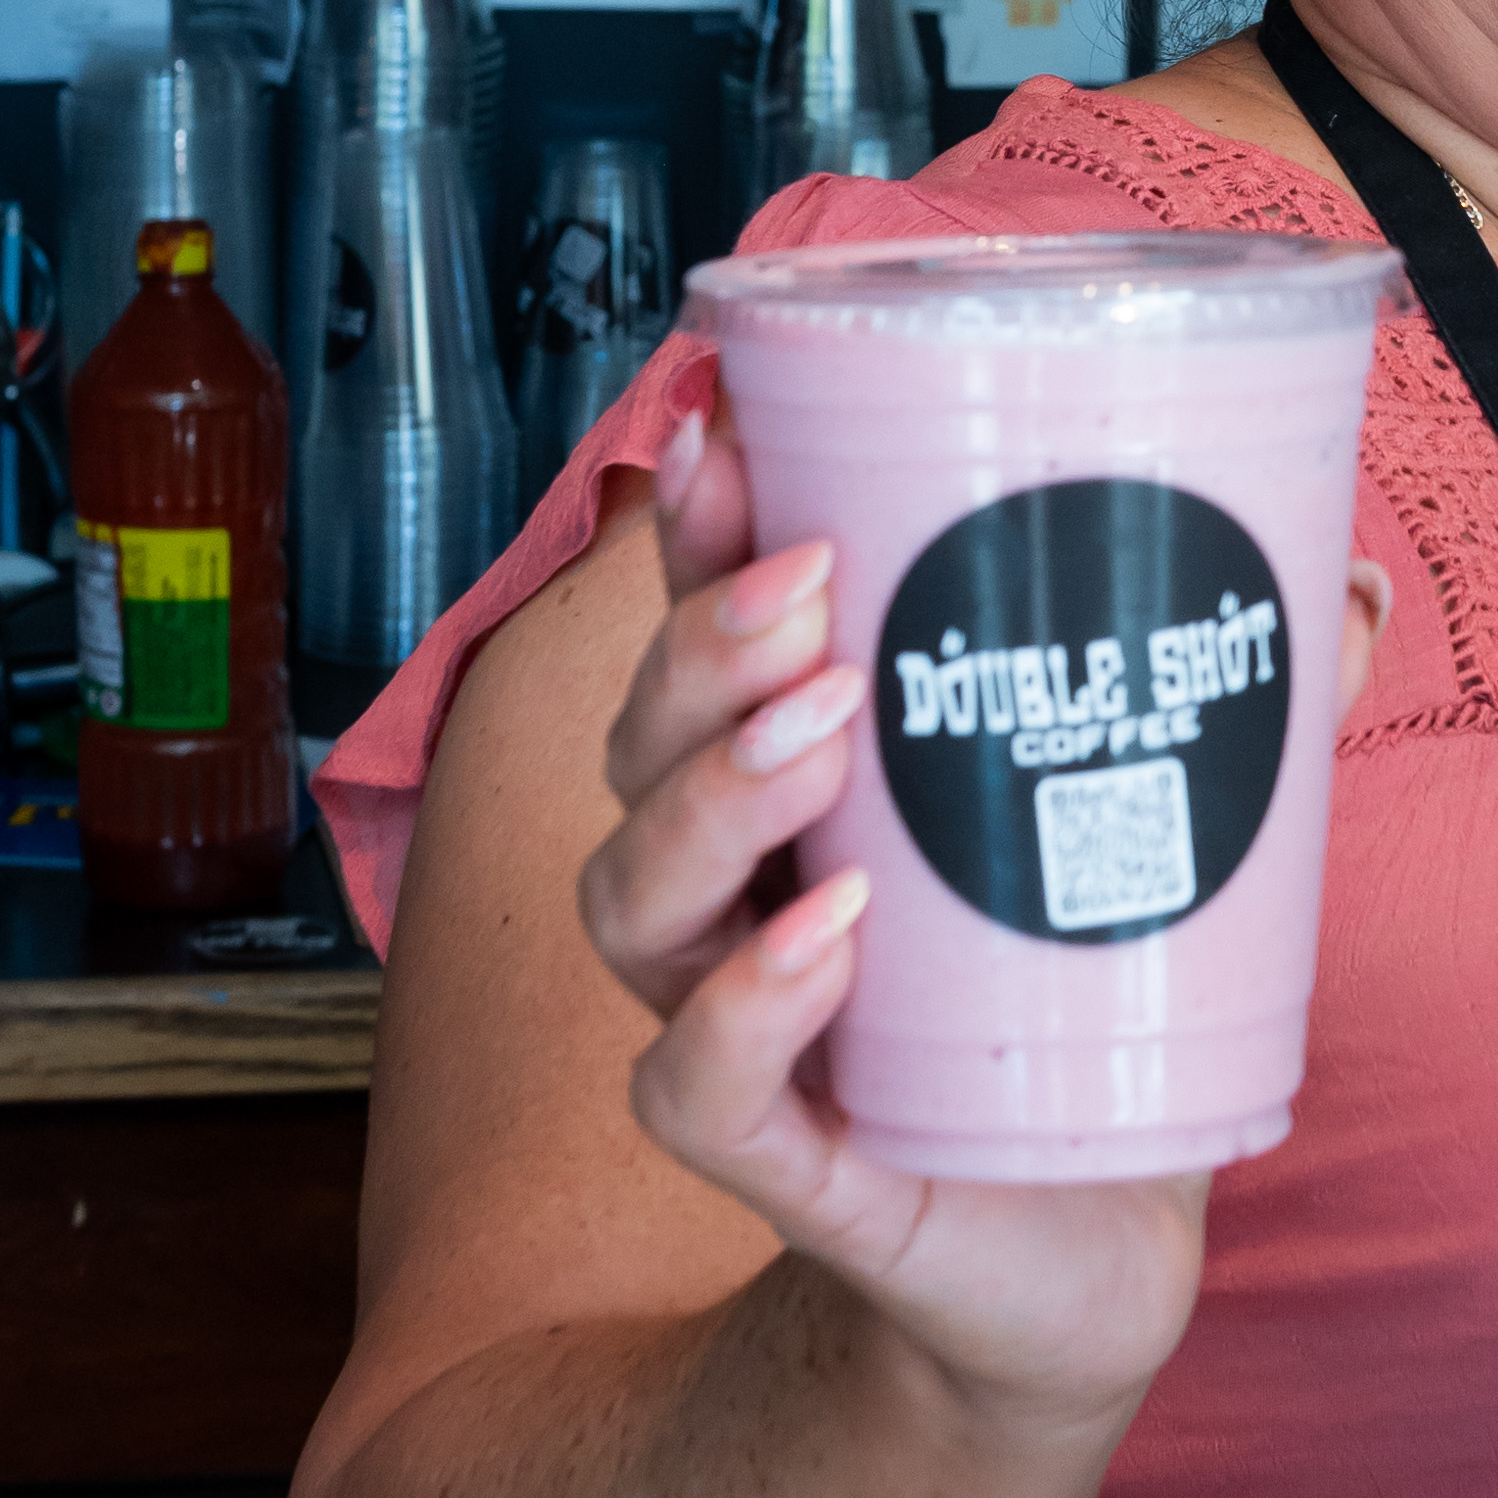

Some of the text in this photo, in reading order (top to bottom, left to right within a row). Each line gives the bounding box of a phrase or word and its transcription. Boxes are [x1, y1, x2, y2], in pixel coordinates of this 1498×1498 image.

[895, 591, 1278, 739] DOUBLE SHOT
[1011, 705, 1203, 769] COFFEE
